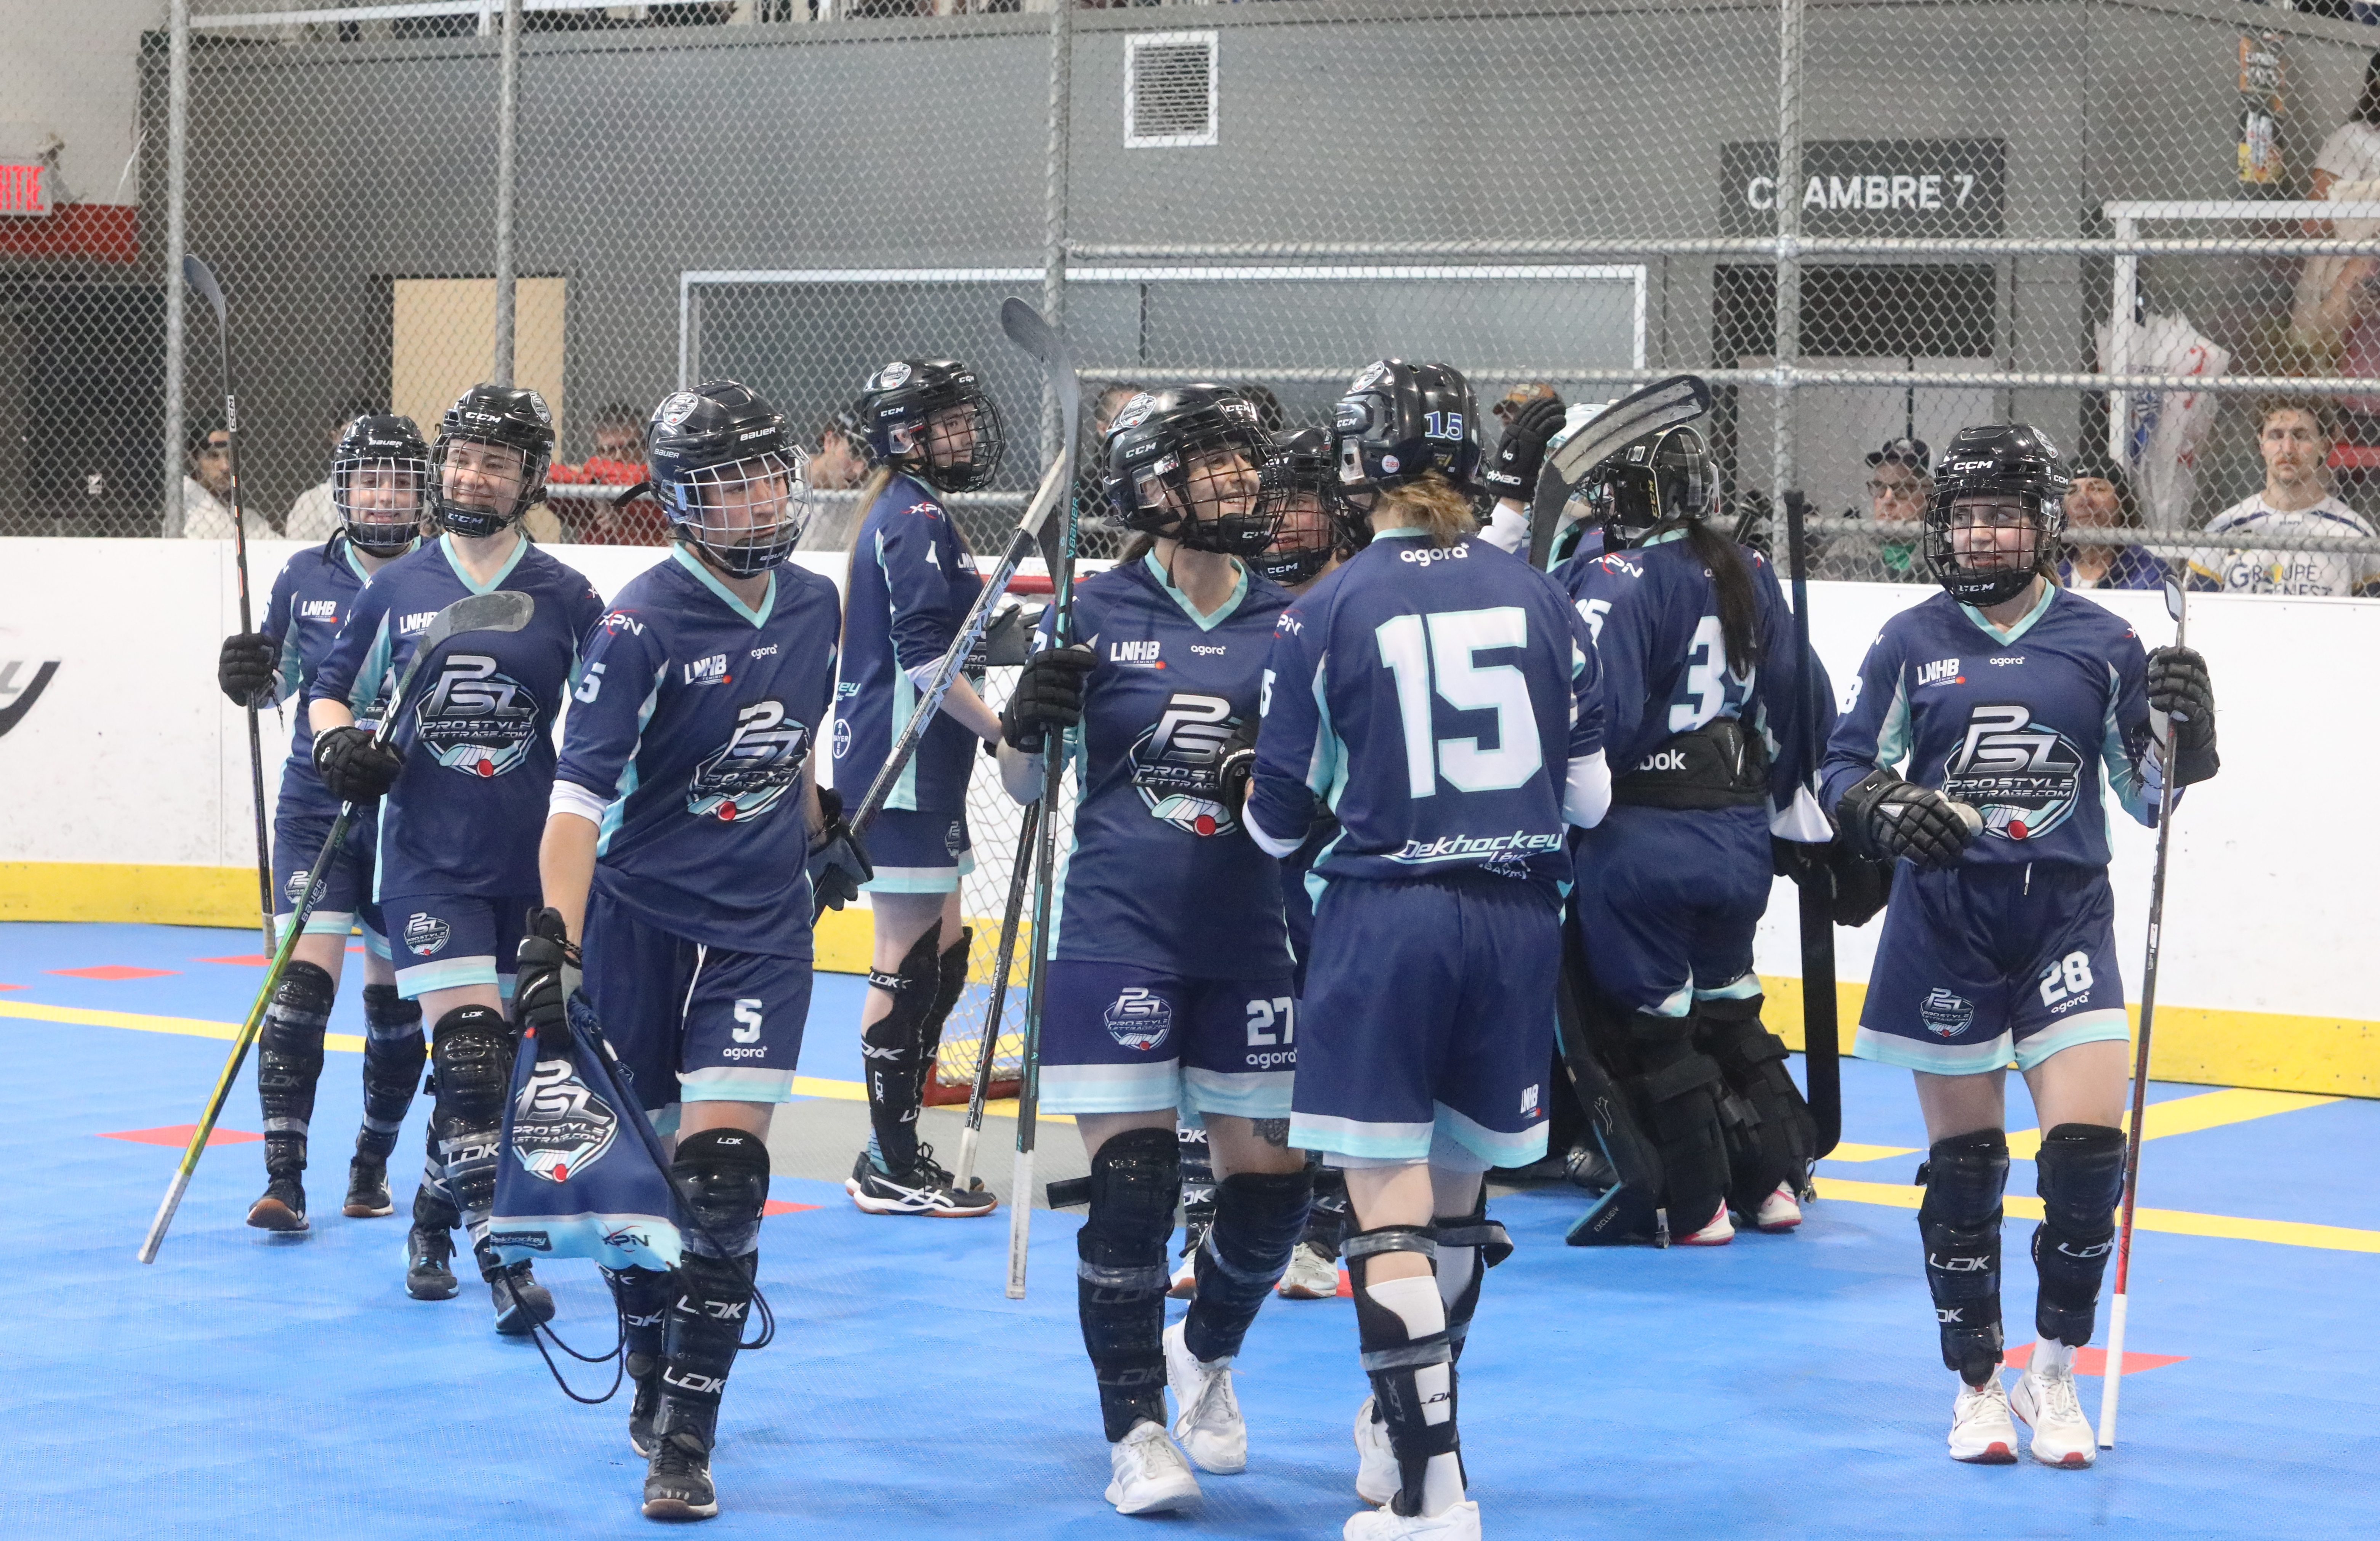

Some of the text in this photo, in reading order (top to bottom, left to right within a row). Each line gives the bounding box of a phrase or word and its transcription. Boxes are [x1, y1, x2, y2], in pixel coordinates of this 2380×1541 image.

[1748, 175, 1974, 210] CAMBRE 7
[465, 411, 502, 423] CCM
[880, 407, 904, 417] CCM
[1336, 418, 1357, 428] CCM
[1424, 410, 1464, 441] 15
[740, 426, 776, 441] BAUER
[654, 448, 680, 459] BAUER
[1125, 442, 1156, 458] CCM
[1953, 461, 1993, 471] CCM
[1487, 470, 1522, 486] DEKAD
[2053, 475, 2068, 485] CCM
[1648, 479, 1659, 518] CCM
[448, 513, 484, 525] CCM
[1069, 497, 1079, 549] BAUER
[1400, 546, 1468, 566] agora
[1267, 562, 1298, 573] CCM
[2229, 563, 2317, 588] GRUPE
[301, 601, 336, 616] LNHB
[599, 612, 647, 636] XPN
[1276, 614, 1303, 636] PN
[751, 647, 777, 660] agora
[1110, 641, 1161, 662] LNHB
[1190, 646, 1224, 655] agora
[685, 654, 727, 685] LNHB
[1989, 658, 2023, 666] agora
[1917, 658, 1960, 686] LNHB
[575, 662, 606, 703] 5
[1375, 606, 1542, 799] 15
[418, 720, 532, 732] PROSTYLE
[422, 730, 529, 738] LETTRAGE.COM
[1145, 694, 1235, 764] PS
[1953, 706, 2076, 775] PSL
[1136, 764, 1216, 778] PROST
[1137, 776, 1219, 790] LETTRAG
[1946, 778, 2074, 790] PROSTYLE
[1947, 790, 2070, 799] LETTRAGE.COM
[1402, 830, 1562, 859] Dekhockey
[301, 878, 325, 923] BAUER
[868, 972, 899, 988] LDK
[2039, 950, 2094, 1008] 28
[2051, 994, 2089, 1014] agora
[732, 999, 762, 1043] 5
[1246, 996, 1294, 1046] 27
[723, 1048, 764, 1060] agora
[861, 1039, 905, 1061] DK
[1246, 1053, 1296, 1069] agora
[1520, 1084, 1539, 1113] LNHB
[717, 1137, 743, 1145] LDK
[1177, 1129, 1208, 1143] DK
[1183, 1188, 1212, 1206] DK
[1929, 1253, 1990, 1271] LDK
[627, 1309, 665, 1327] DK
[1936, 1308, 1963, 1323] DK
[663, 1366, 728, 1394] LDK
